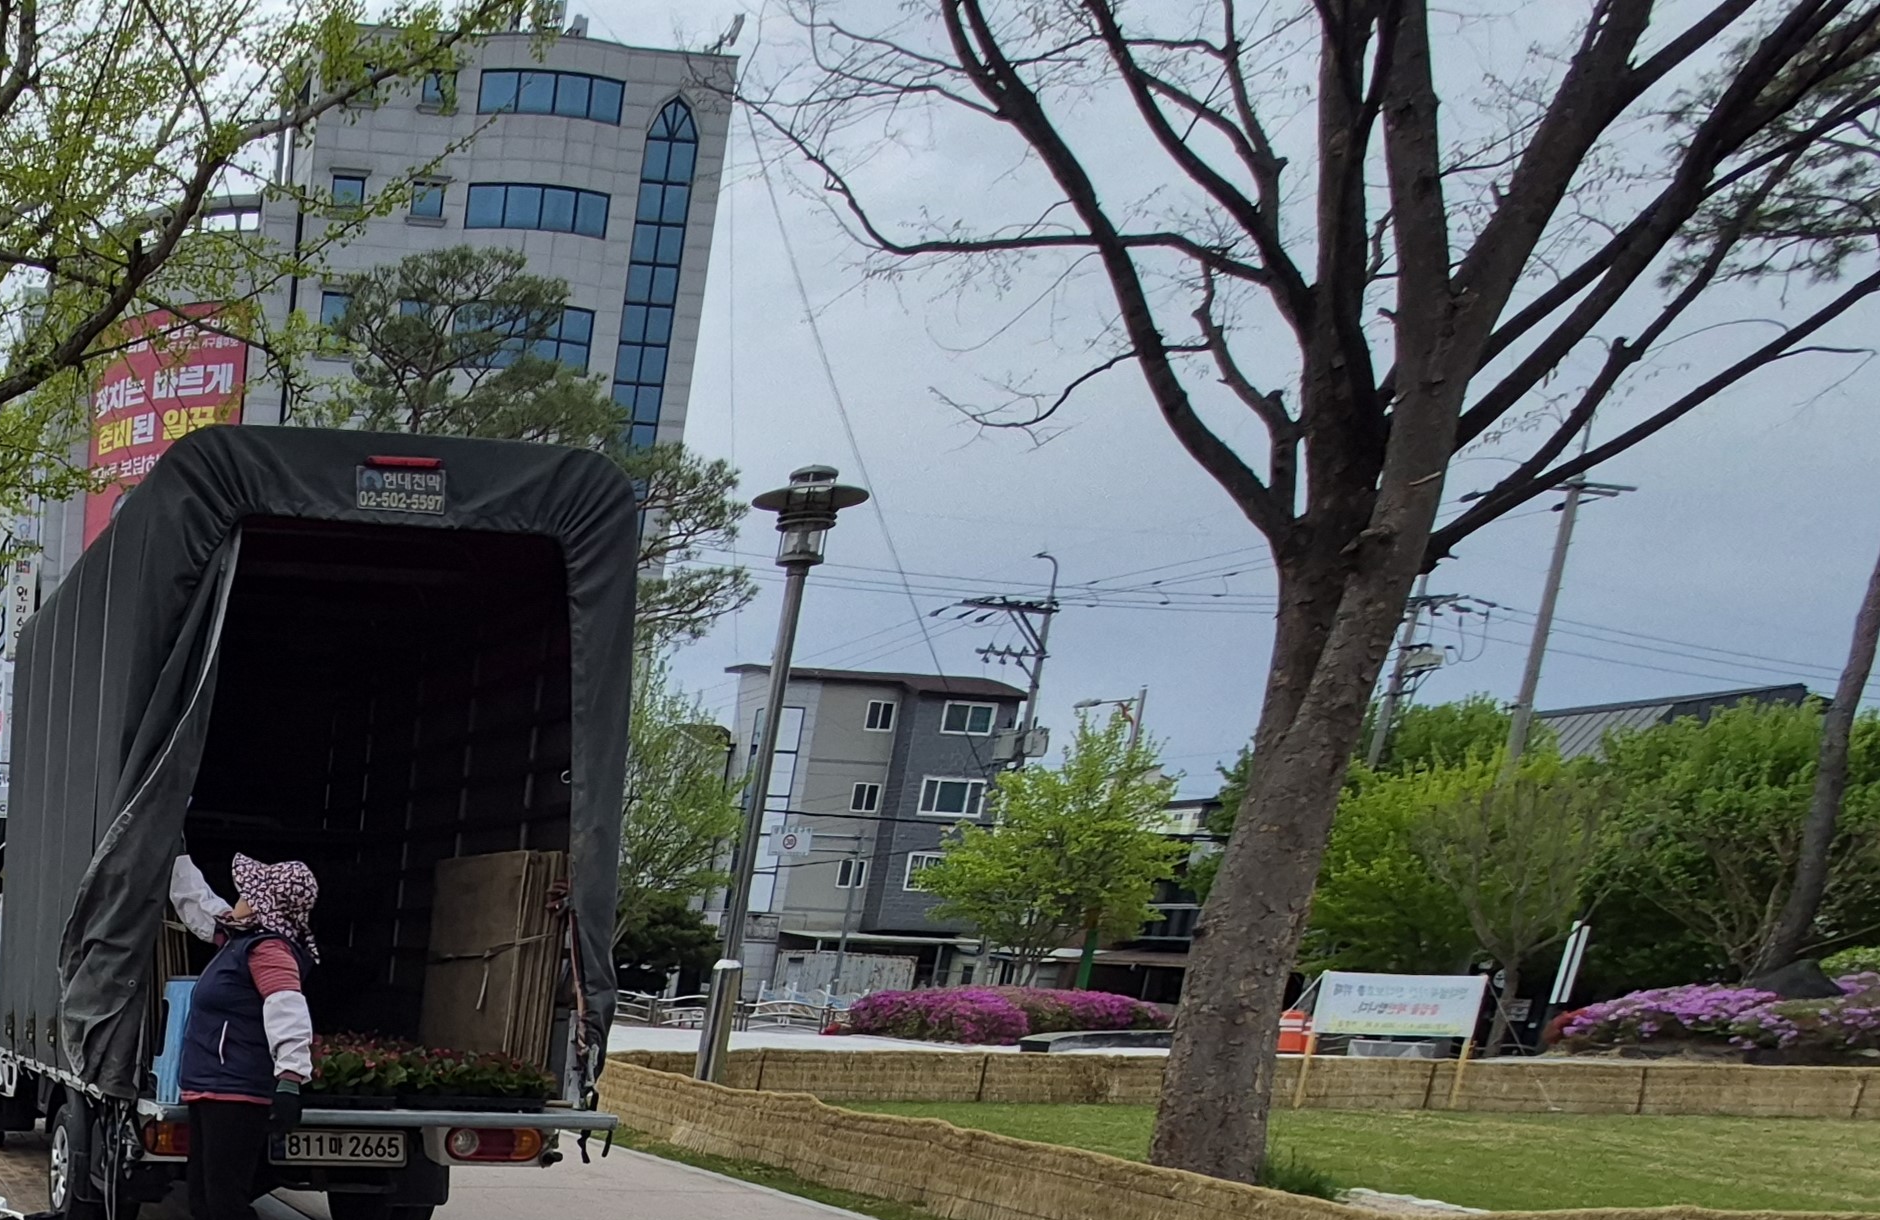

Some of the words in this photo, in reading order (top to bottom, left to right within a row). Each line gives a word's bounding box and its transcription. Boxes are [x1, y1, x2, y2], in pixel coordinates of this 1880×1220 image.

[95, 377, 146, 419] 정치는
[152, 363, 234, 399] 바르게
[97, 412, 156, 456] 준비된
[383, 472, 442, 491] 현대천막
[359, 491, 443, 511] 02-502-5597
[287, 1135, 343, 1157] 811마
[348, 1136, 400, 1158] 2665
